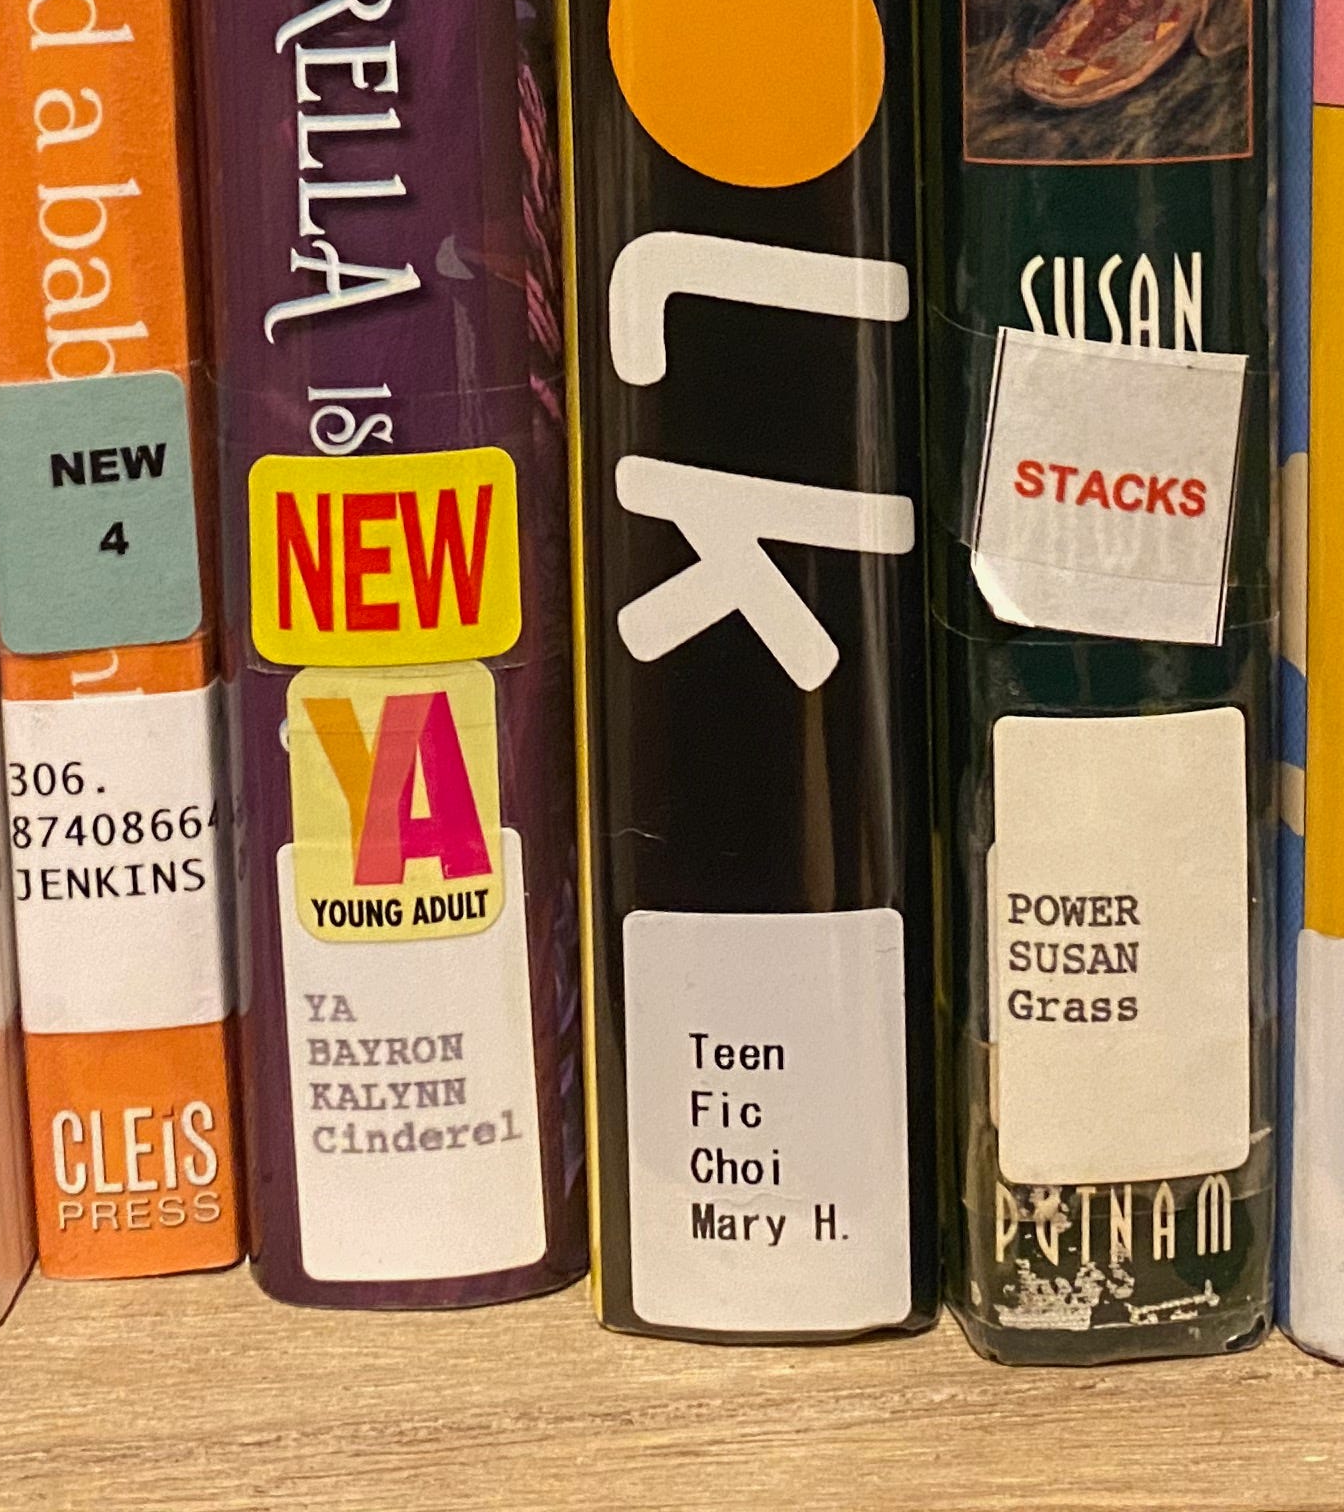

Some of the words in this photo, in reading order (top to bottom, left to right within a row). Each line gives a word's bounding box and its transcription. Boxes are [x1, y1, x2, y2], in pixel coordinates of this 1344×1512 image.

[32, 85, 104, 154] a
[1020, 252, 1203, 352] SUSAN
[49, 442, 168, 489] NEW
[1014, 460, 1207, 518] STACKS
[99, 521, 130, 555] 4
[276, 484, 494, 633] NEW
[9, 760, 106, 797] 306.
[301, 691, 493, 885] YA
[16, 858, 207, 901] JENKINS
[311, 896, 403, 928] YOUNG
[411, 890, 489, 926] ADULT
[1007, 892, 1140, 928] POWER
[1007, 939, 1140, 976] SUSAN
[306, 994, 357, 1025] YA
[1007, 988, 1140, 1025] Grass
[309, 1035, 464, 1068] BAYRON
[690, 1033, 786, 1071] Teen
[311, 1078, 467, 1112] KALYNN
[692, 1091, 763, 1128] Fic
[313, 1111, 523, 1155] Cinderel
[690, 1148, 782, 1186] Choi
[59, 1191, 222, 1231] PRESS
[690, 1205, 786, 1247] Mary
[815, 1203, 851, 1242] H.
